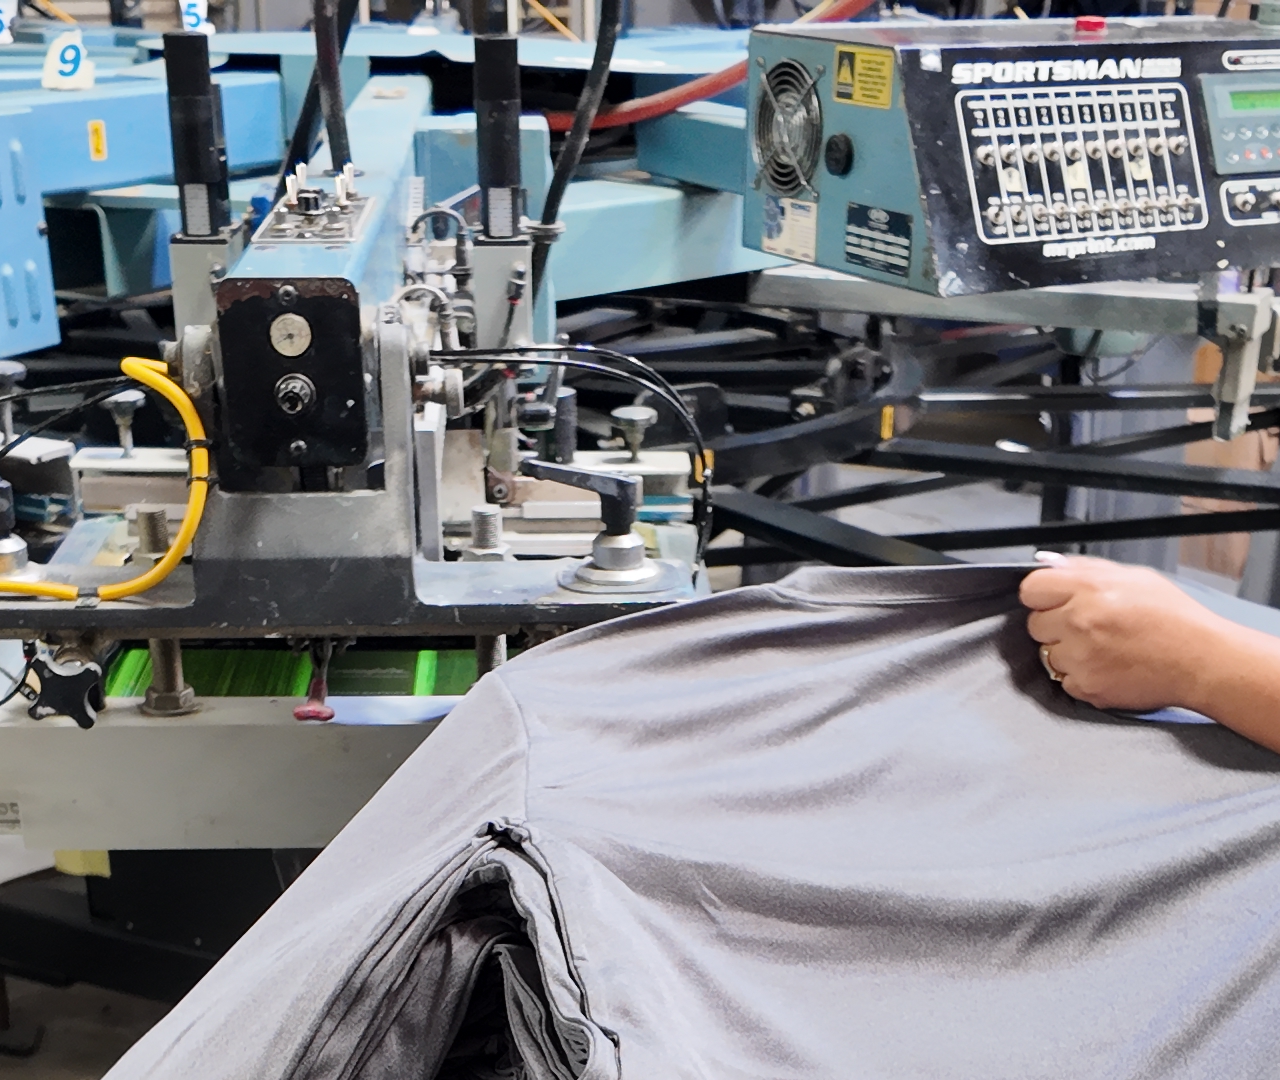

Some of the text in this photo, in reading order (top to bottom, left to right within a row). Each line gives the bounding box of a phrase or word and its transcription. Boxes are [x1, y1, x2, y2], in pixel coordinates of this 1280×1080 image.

[185, 3, 200, 28] 5
[58, 44, 81, 76] 9
[951, 57, 1142, 84] SPORTSMAN
